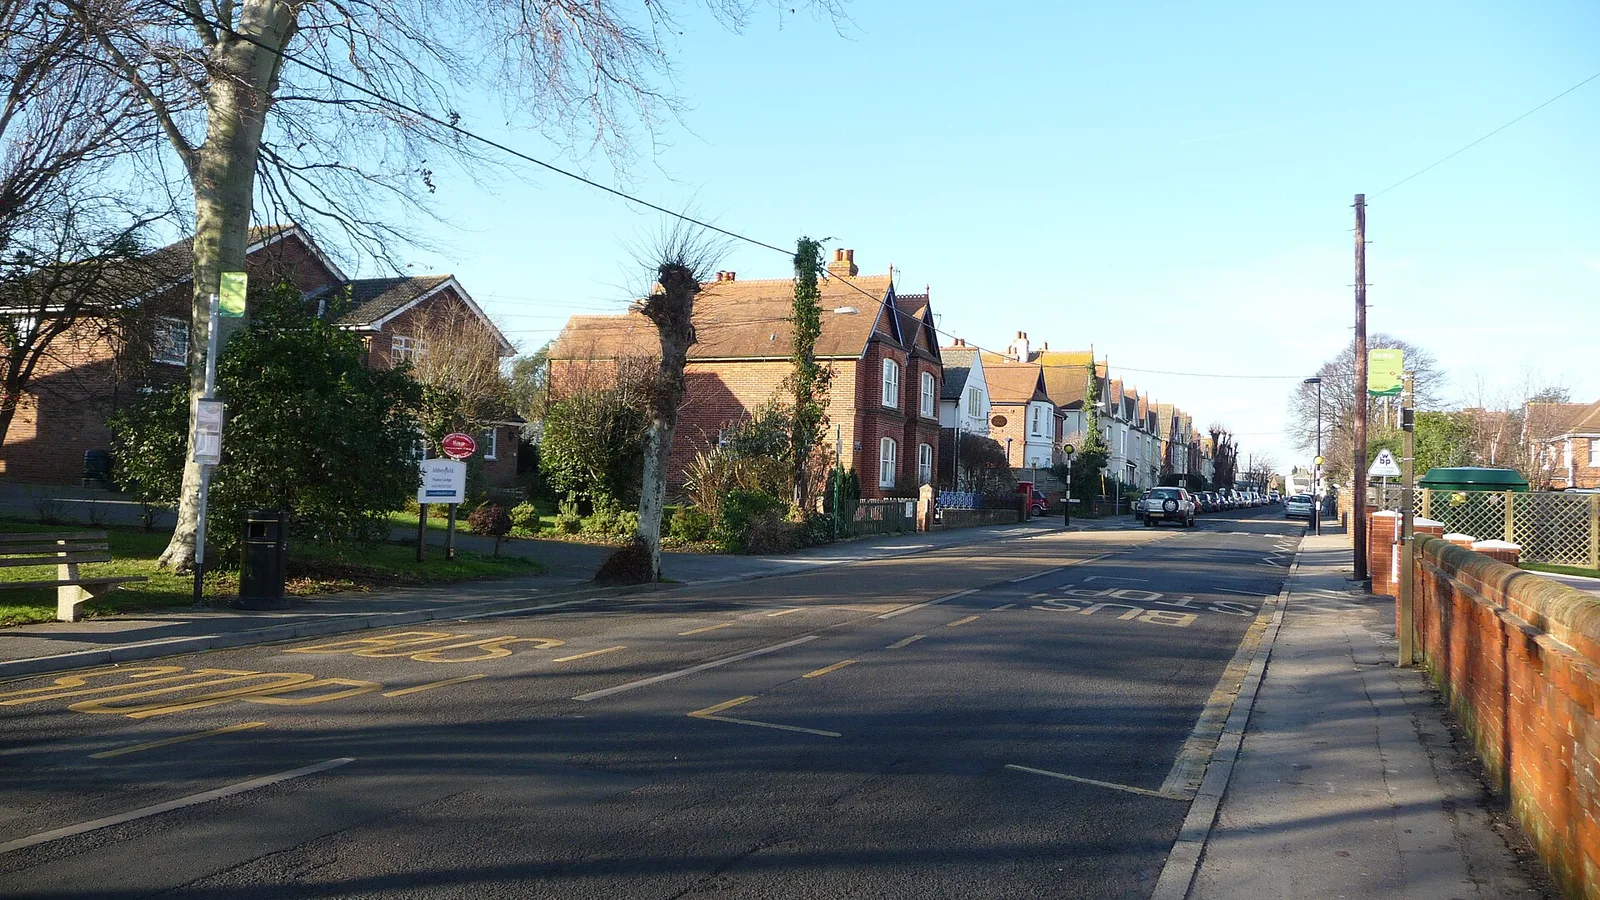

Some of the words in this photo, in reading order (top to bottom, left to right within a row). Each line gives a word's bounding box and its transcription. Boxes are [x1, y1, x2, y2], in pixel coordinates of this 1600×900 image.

[1031, 598, 1199, 627] BUS
[1064, 587, 1257, 617] STOP
[282, 631, 566, 663] BUS
[0, 666, 384, 719] STOP
